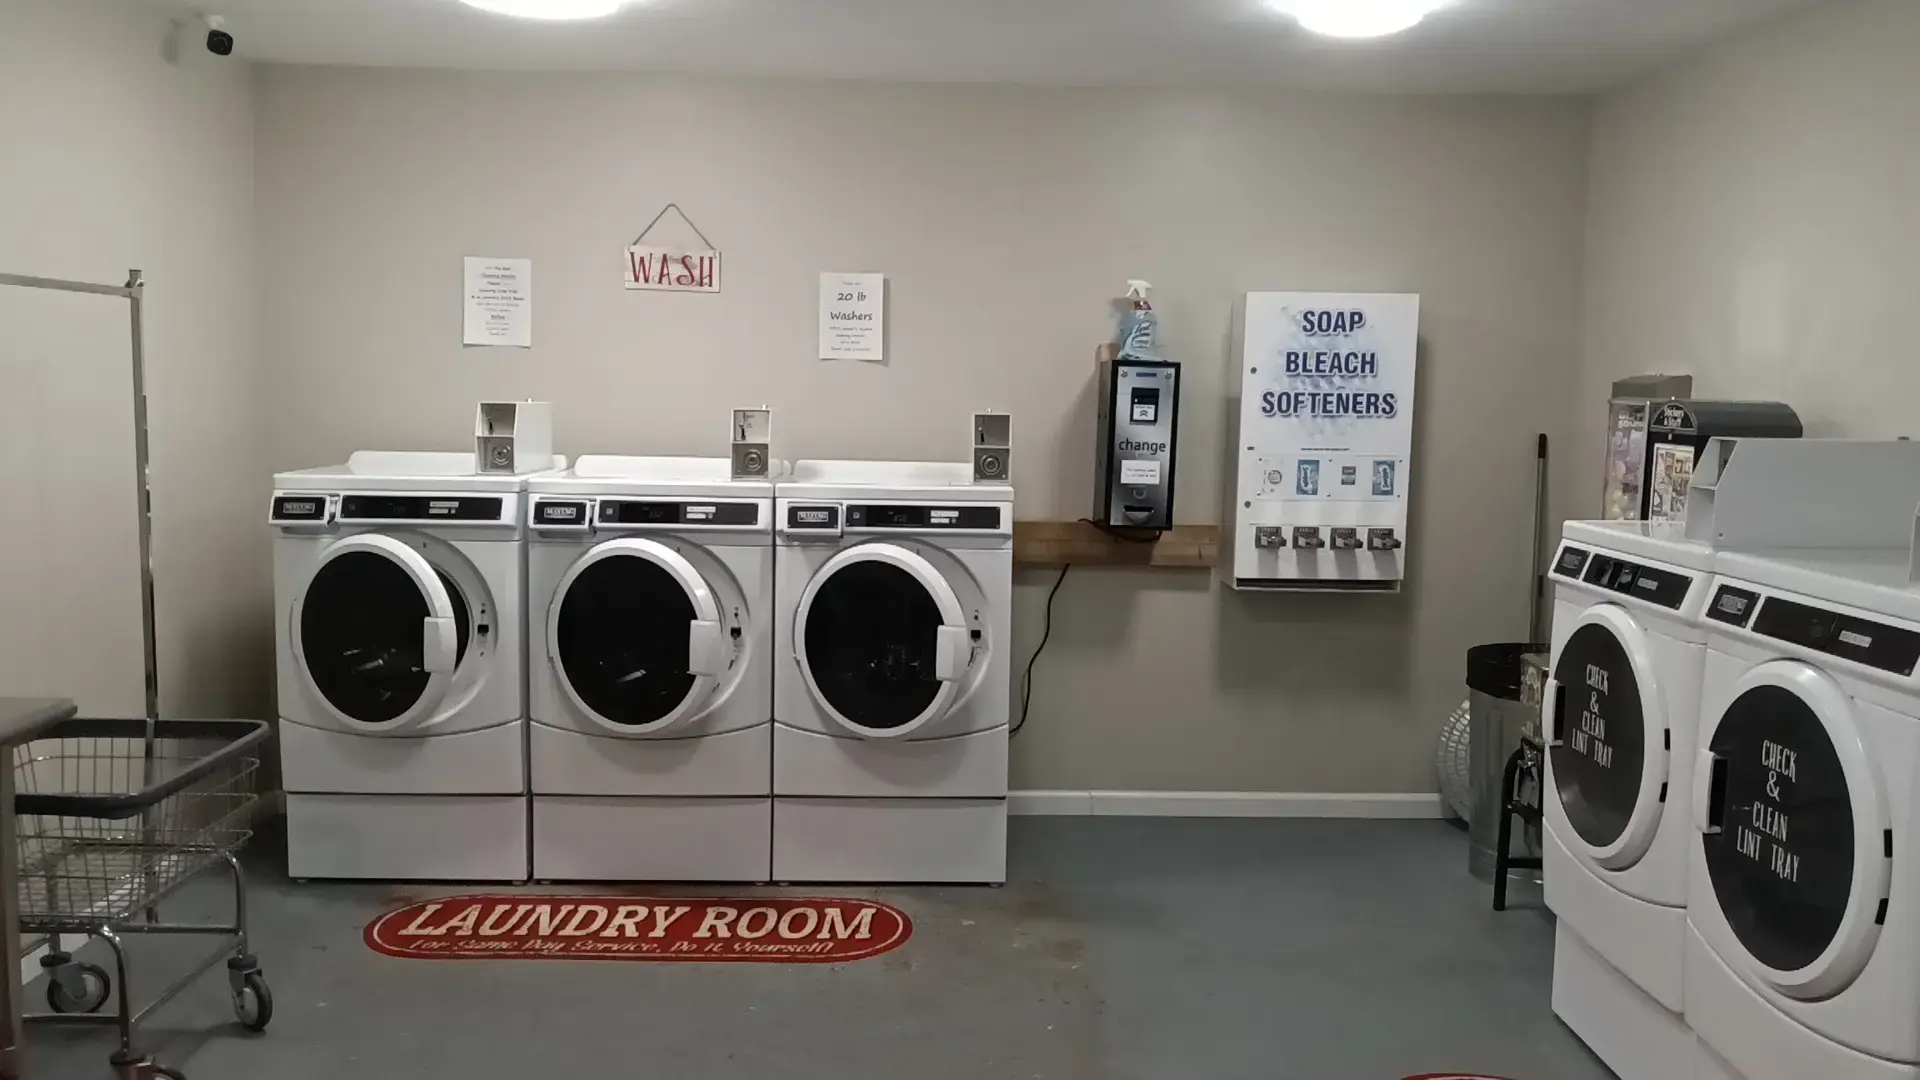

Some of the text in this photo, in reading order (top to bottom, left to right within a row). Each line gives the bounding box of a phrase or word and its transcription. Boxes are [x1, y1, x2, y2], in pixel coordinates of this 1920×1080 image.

[629, 251, 713, 288] WASH
[837, 291, 867, 302] 20 lb
[830, 310, 873, 321] Washers
[1301, 310, 1364, 334] SOAP
[1285, 351, 1376, 375] BLEACH
[1261, 391, 1396, 415] SOFTENERS
[1118, 438, 1166, 456] change
[1586, 663, 1609, 696] CHECK
[1589, 691, 1600, 715] &
[1581, 710, 1606, 741] CLEAN
[1571, 728, 1613, 769] LINT TRAY
[1761, 739, 1798, 784] CHECK
[1766, 770, 1781, 802] &
[1752, 800, 1789, 843] CLEAN
[1736, 825, 1800, 883] LINT TRAY
[398, 903, 877, 940] LAUNDRY ROOM
[408, 939, 450, 950] For
[453, 939, 519, 951] Same
[521, 938, 568, 953] Day
[669, 940, 697, 952] Do
